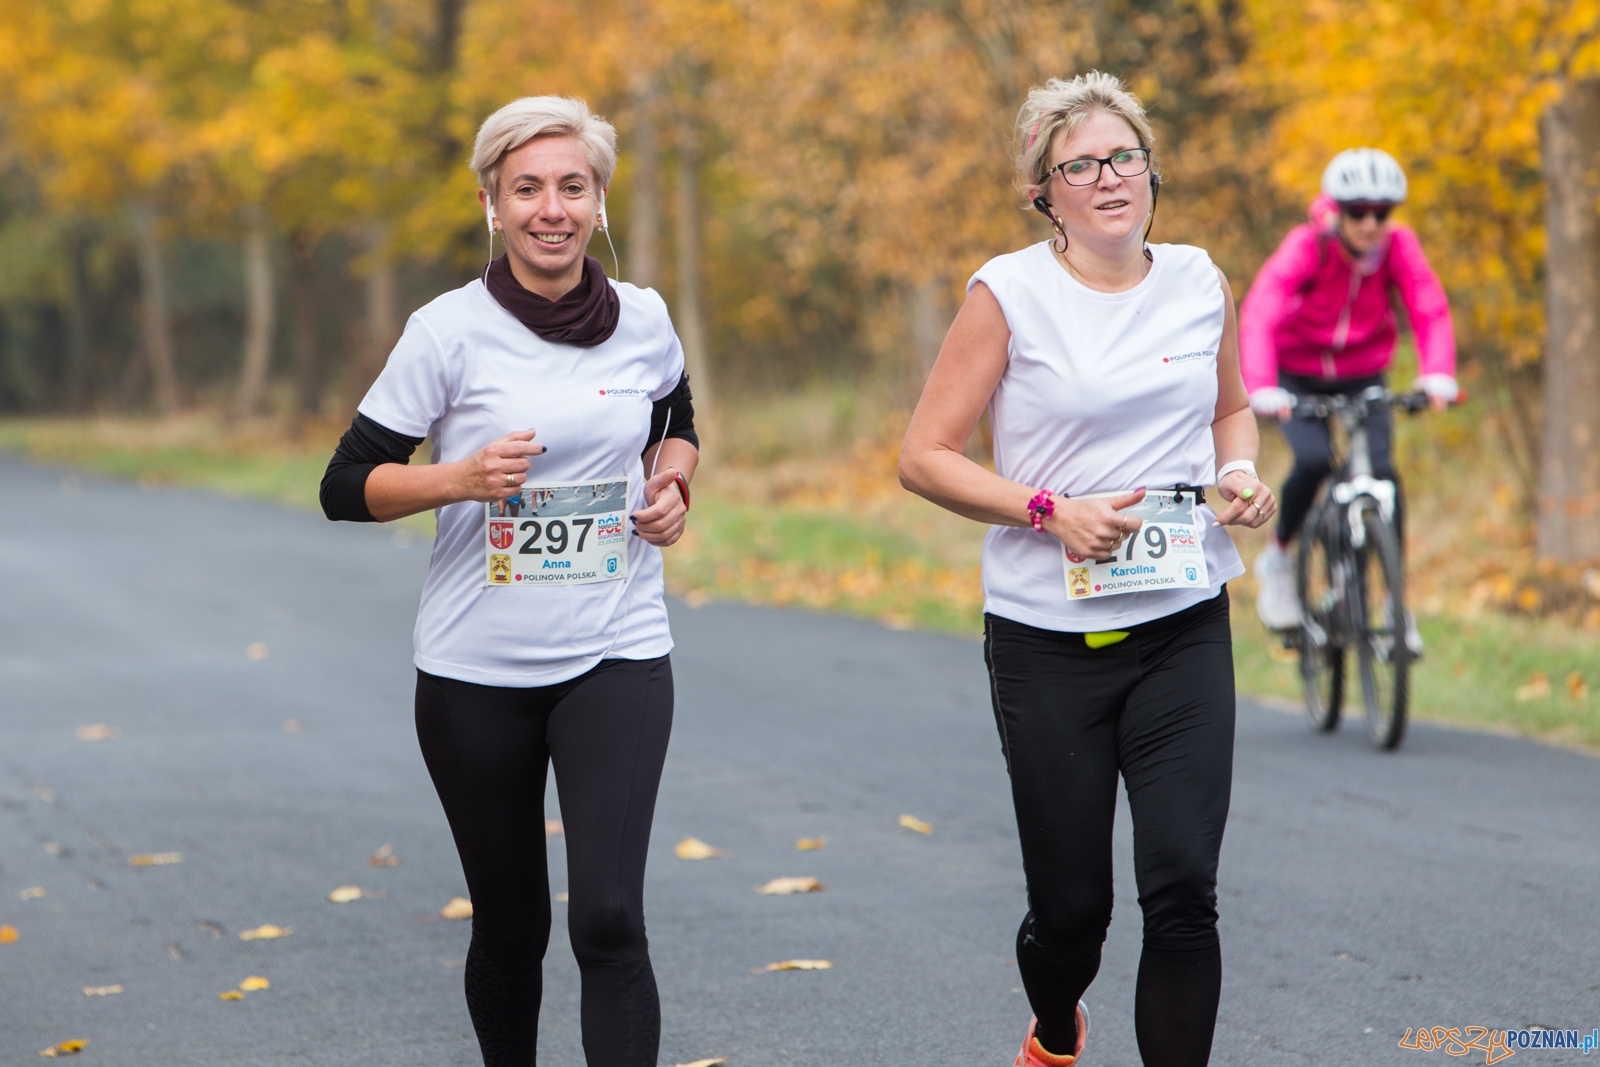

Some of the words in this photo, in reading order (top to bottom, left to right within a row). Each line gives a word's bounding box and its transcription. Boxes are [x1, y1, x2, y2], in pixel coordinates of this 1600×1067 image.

[518, 517, 594, 555] 297
[1095, 525, 1168, 565] 79
[542, 559, 571, 570] Anna
[1110, 564, 1156, 577] Karolina
[523, 573, 565, 581] POLINOVA
[566, 571, 597, 580] POLSKA
[1102, 579, 1144, 591] POLINOVA
[1144, 576, 1176, 586] POLSKA
